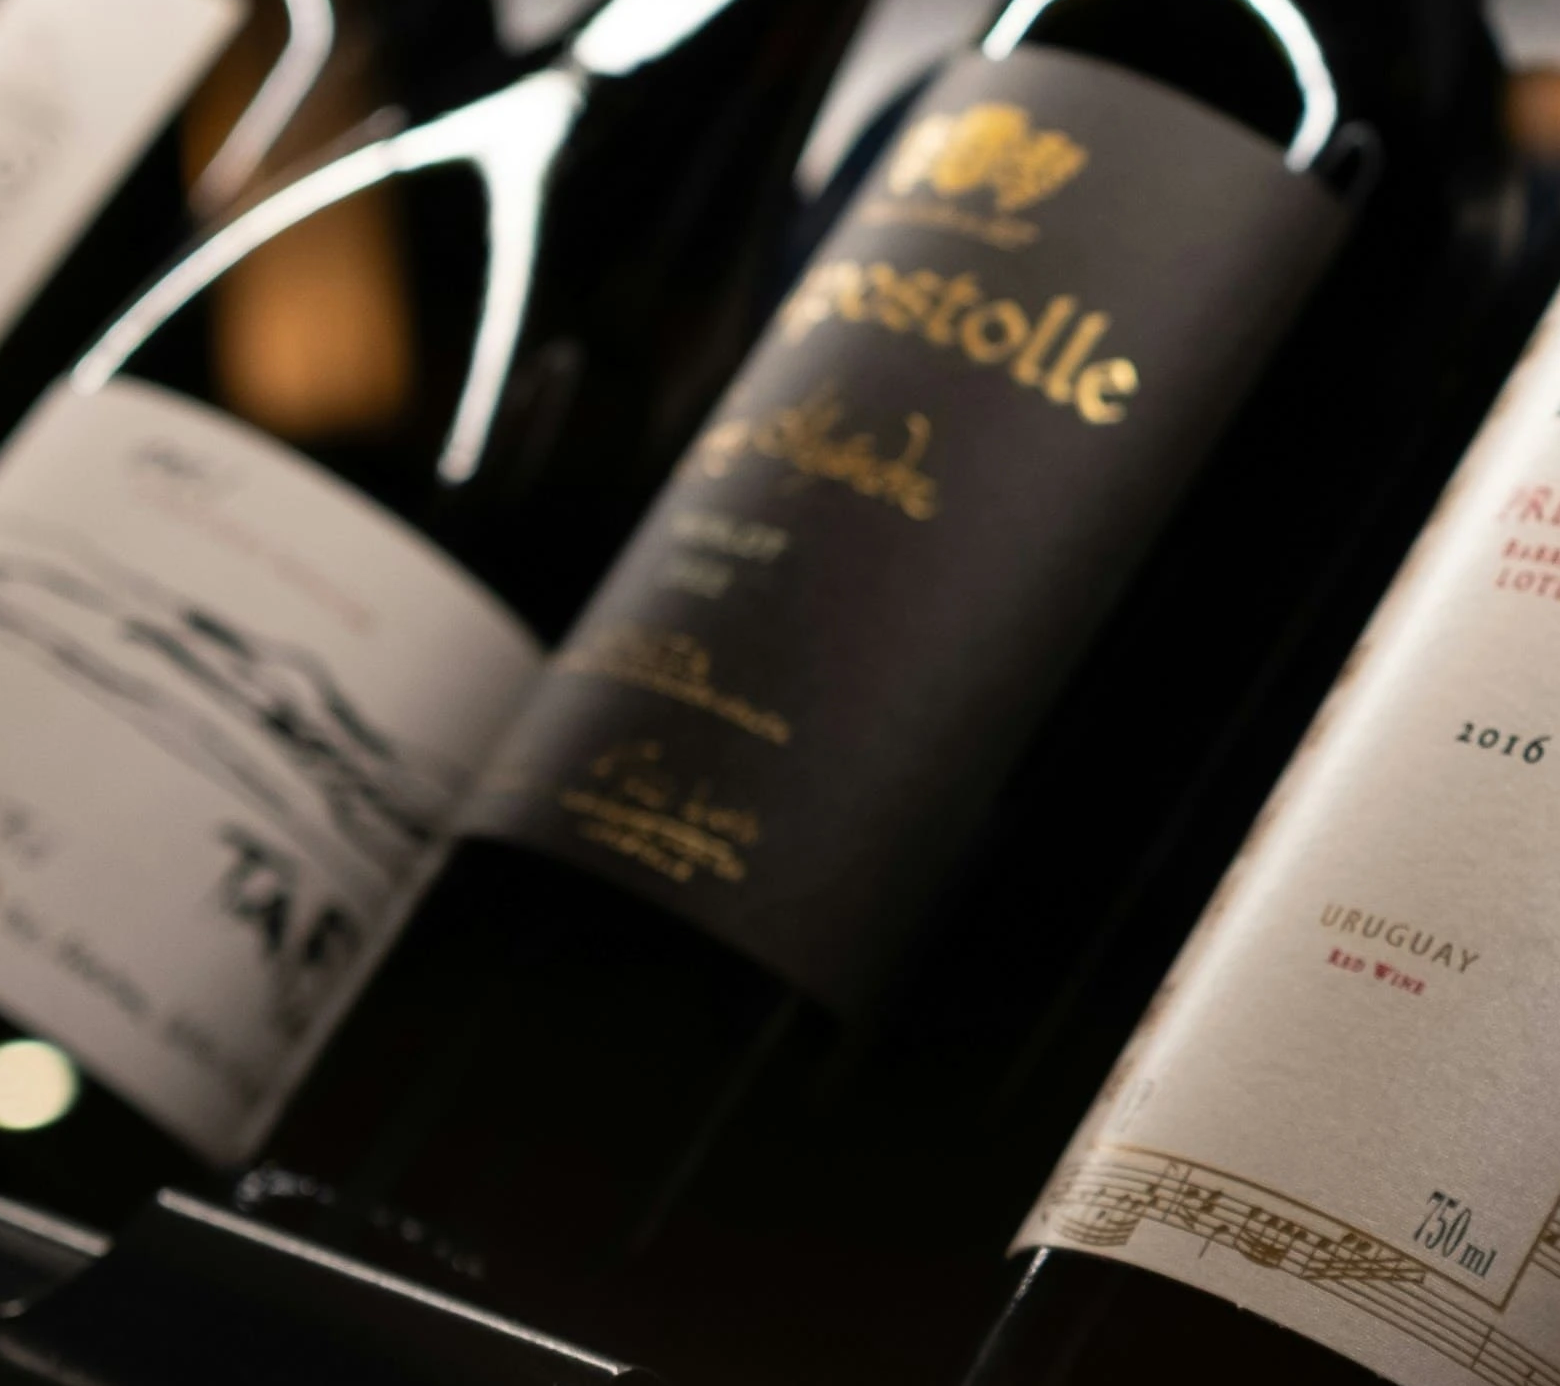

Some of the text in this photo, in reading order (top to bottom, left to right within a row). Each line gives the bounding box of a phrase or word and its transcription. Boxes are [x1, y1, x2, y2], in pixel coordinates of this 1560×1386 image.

[1456, 722, 1553, 764] 2016
[1319, 903, 1481, 974] URUGUAY
[1328, 946, 1427, 996] RED WINE
[1413, 1191, 1498, 1278] 750 ml
